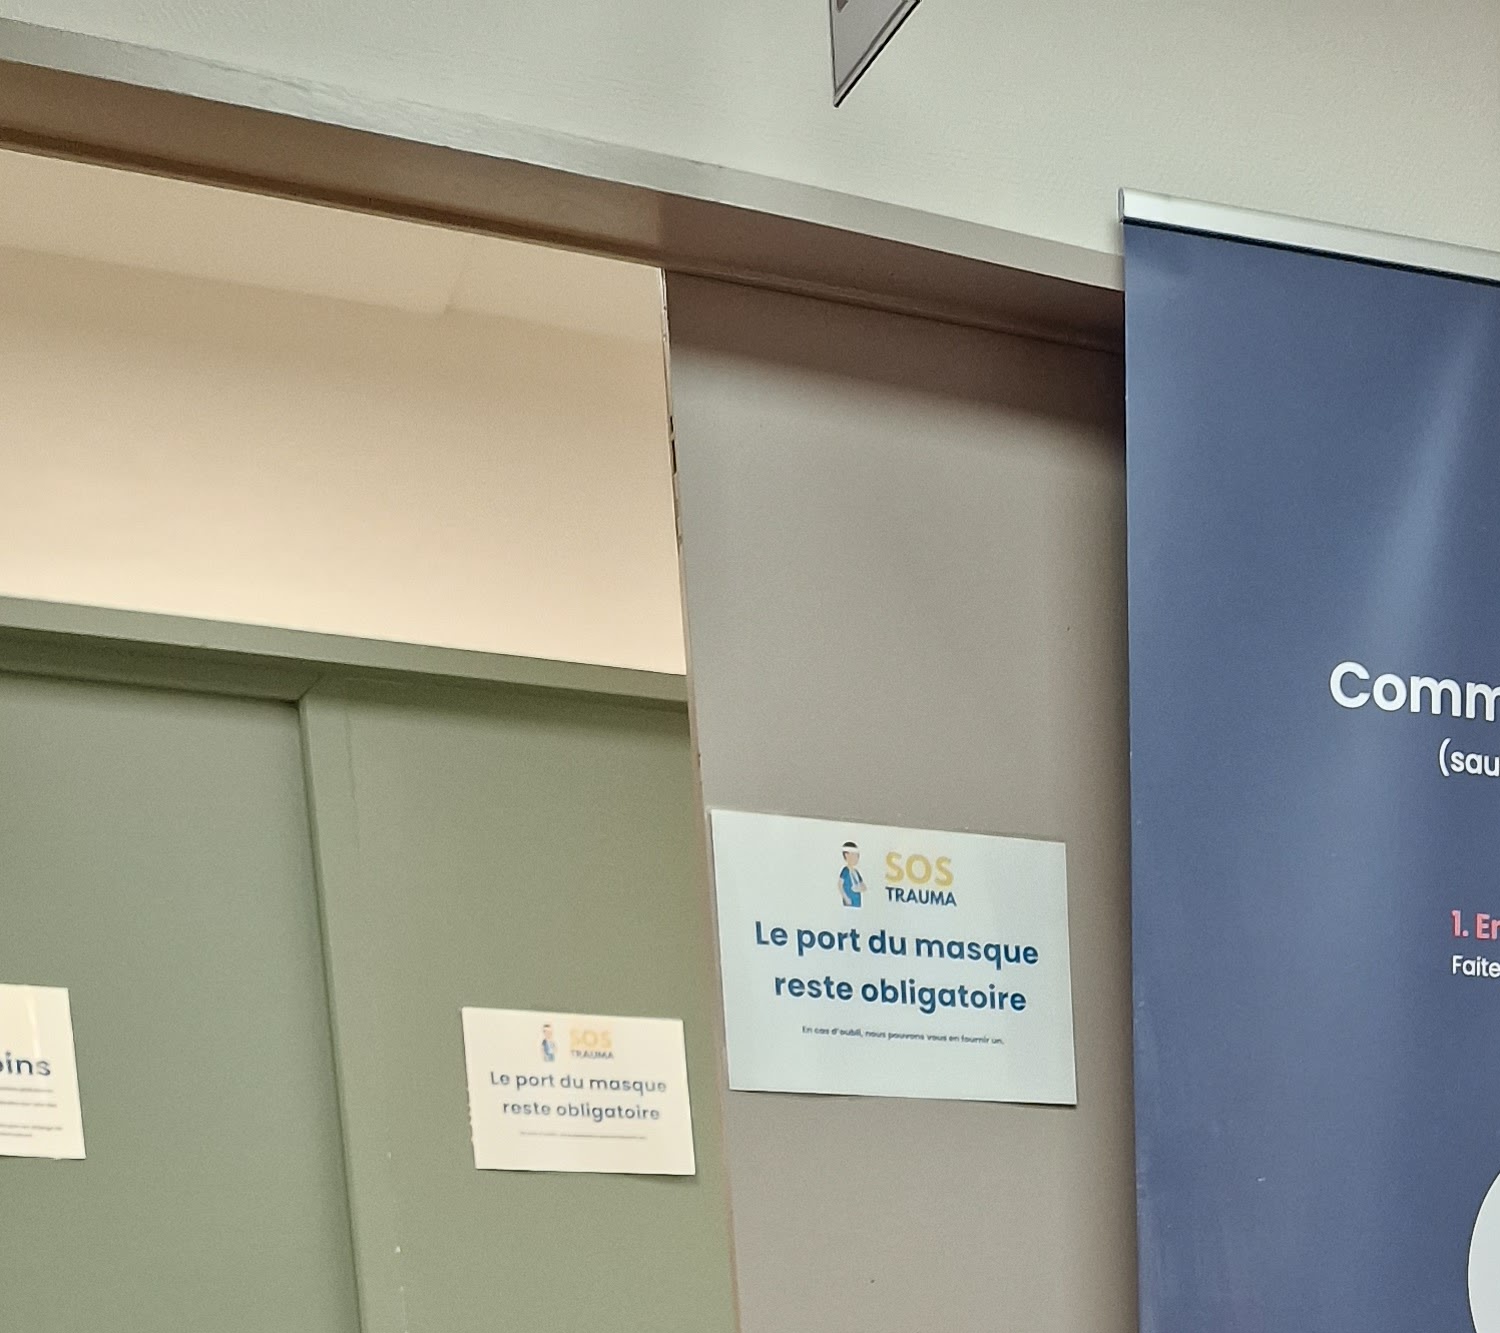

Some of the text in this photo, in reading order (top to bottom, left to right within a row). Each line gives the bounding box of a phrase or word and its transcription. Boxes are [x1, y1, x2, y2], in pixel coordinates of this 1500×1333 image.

[885, 851, 955, 887] SOS
[885, 886, 957, 907] TRAUMA
[1451, 910, 1469, 939] 1.
[755, 921, 1039, 970] Le port du masque
[774, 975, 1027, 1014] reste obligatoire
[569, 1028, 613, 1049] SOS
[865, 1030, 886, 1038] nous
[0, 1051, 51, 1076] ins
[570, 1050, 614, 1059] TRAUMA
[490, 1071, 667, 1095] Le port du masque
[503, 1101, 660, 1123] reste obligatoire
